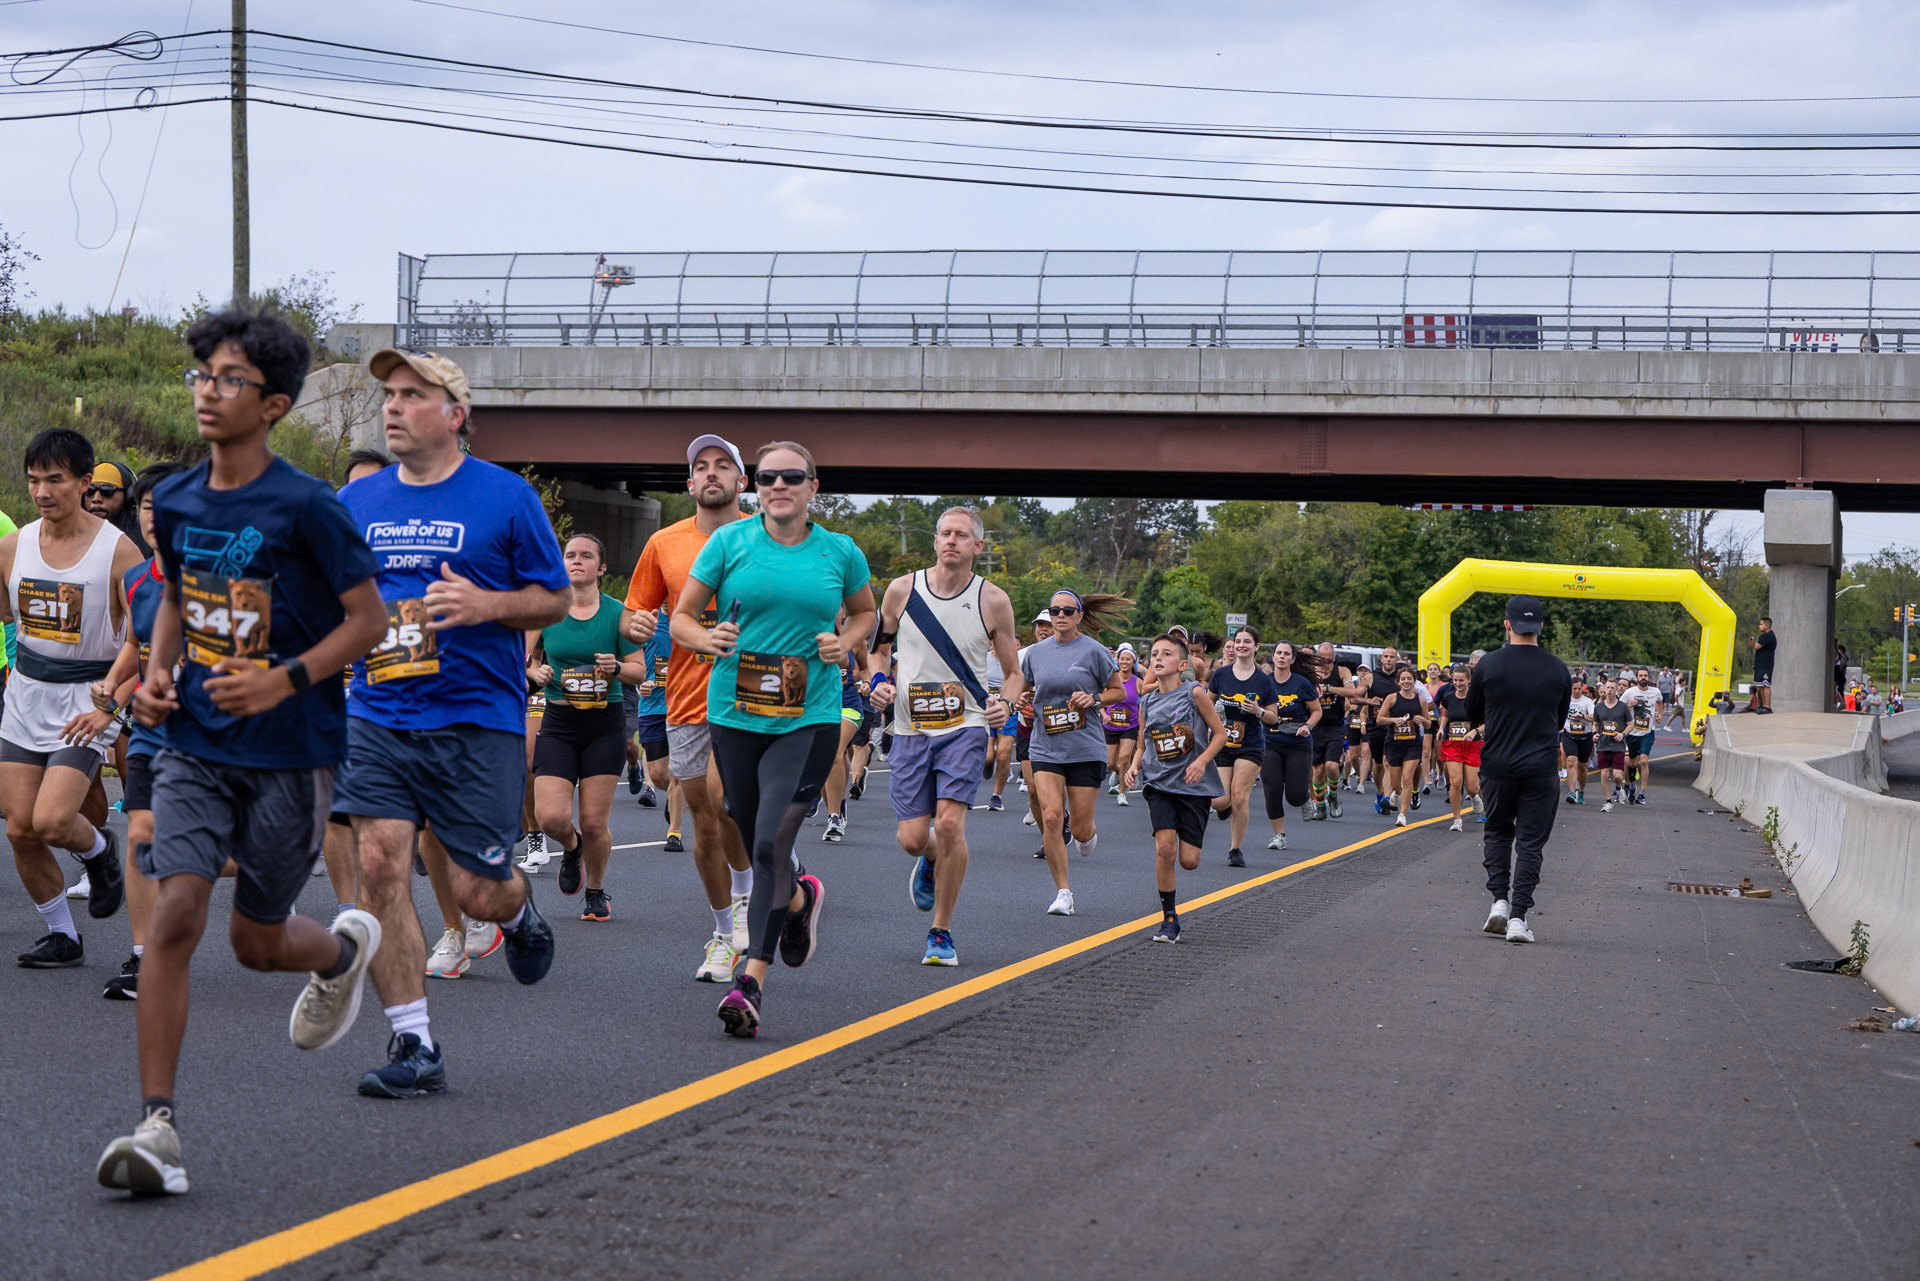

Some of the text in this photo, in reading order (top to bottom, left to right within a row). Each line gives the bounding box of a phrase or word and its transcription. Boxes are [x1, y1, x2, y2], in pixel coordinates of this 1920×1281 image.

[374, 525, 454, 538] POWER OF US
[426, 538, 449, 546] FINISH
[384, 555, 422, 569] JDRF
[19, 588, 44, 597] CHASE
[182, 586, 210, 600] CHASE
[28, 598, 69, 620] 211
[186, 600, 260, 639] 347
[741, 654, 756, 662] THE
[739, 662, 766, 671] CHASE
[565, 678, 608, 692] 322
[760, 674, 781, 693] 2
[913, 696, 960, 712] 229
[1048, 711, 1080, 726] 128
[1157, 735, 1186, 752] 127
